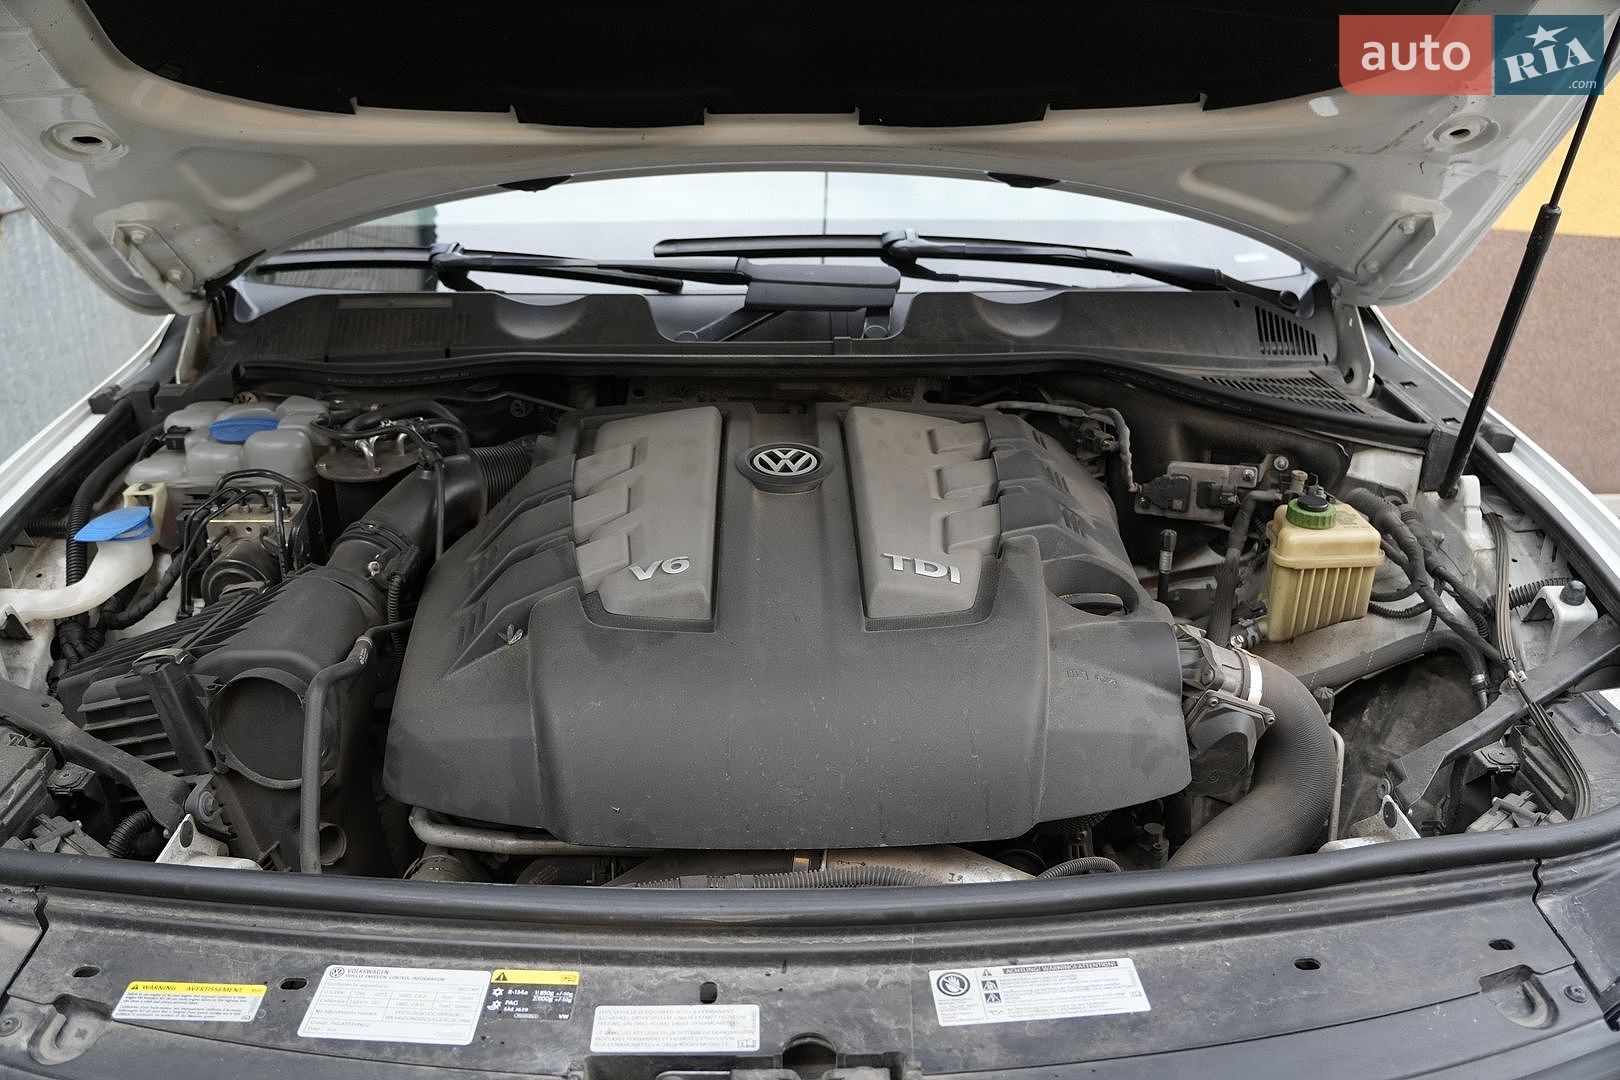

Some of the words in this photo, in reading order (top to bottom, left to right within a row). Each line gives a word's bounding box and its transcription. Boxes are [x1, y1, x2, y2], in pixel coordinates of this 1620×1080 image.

[630, 556, 690, 581] V6
[883, 553, 961, 584] TDI
[185, 985, 243, 993] AVERTISSEMENT
